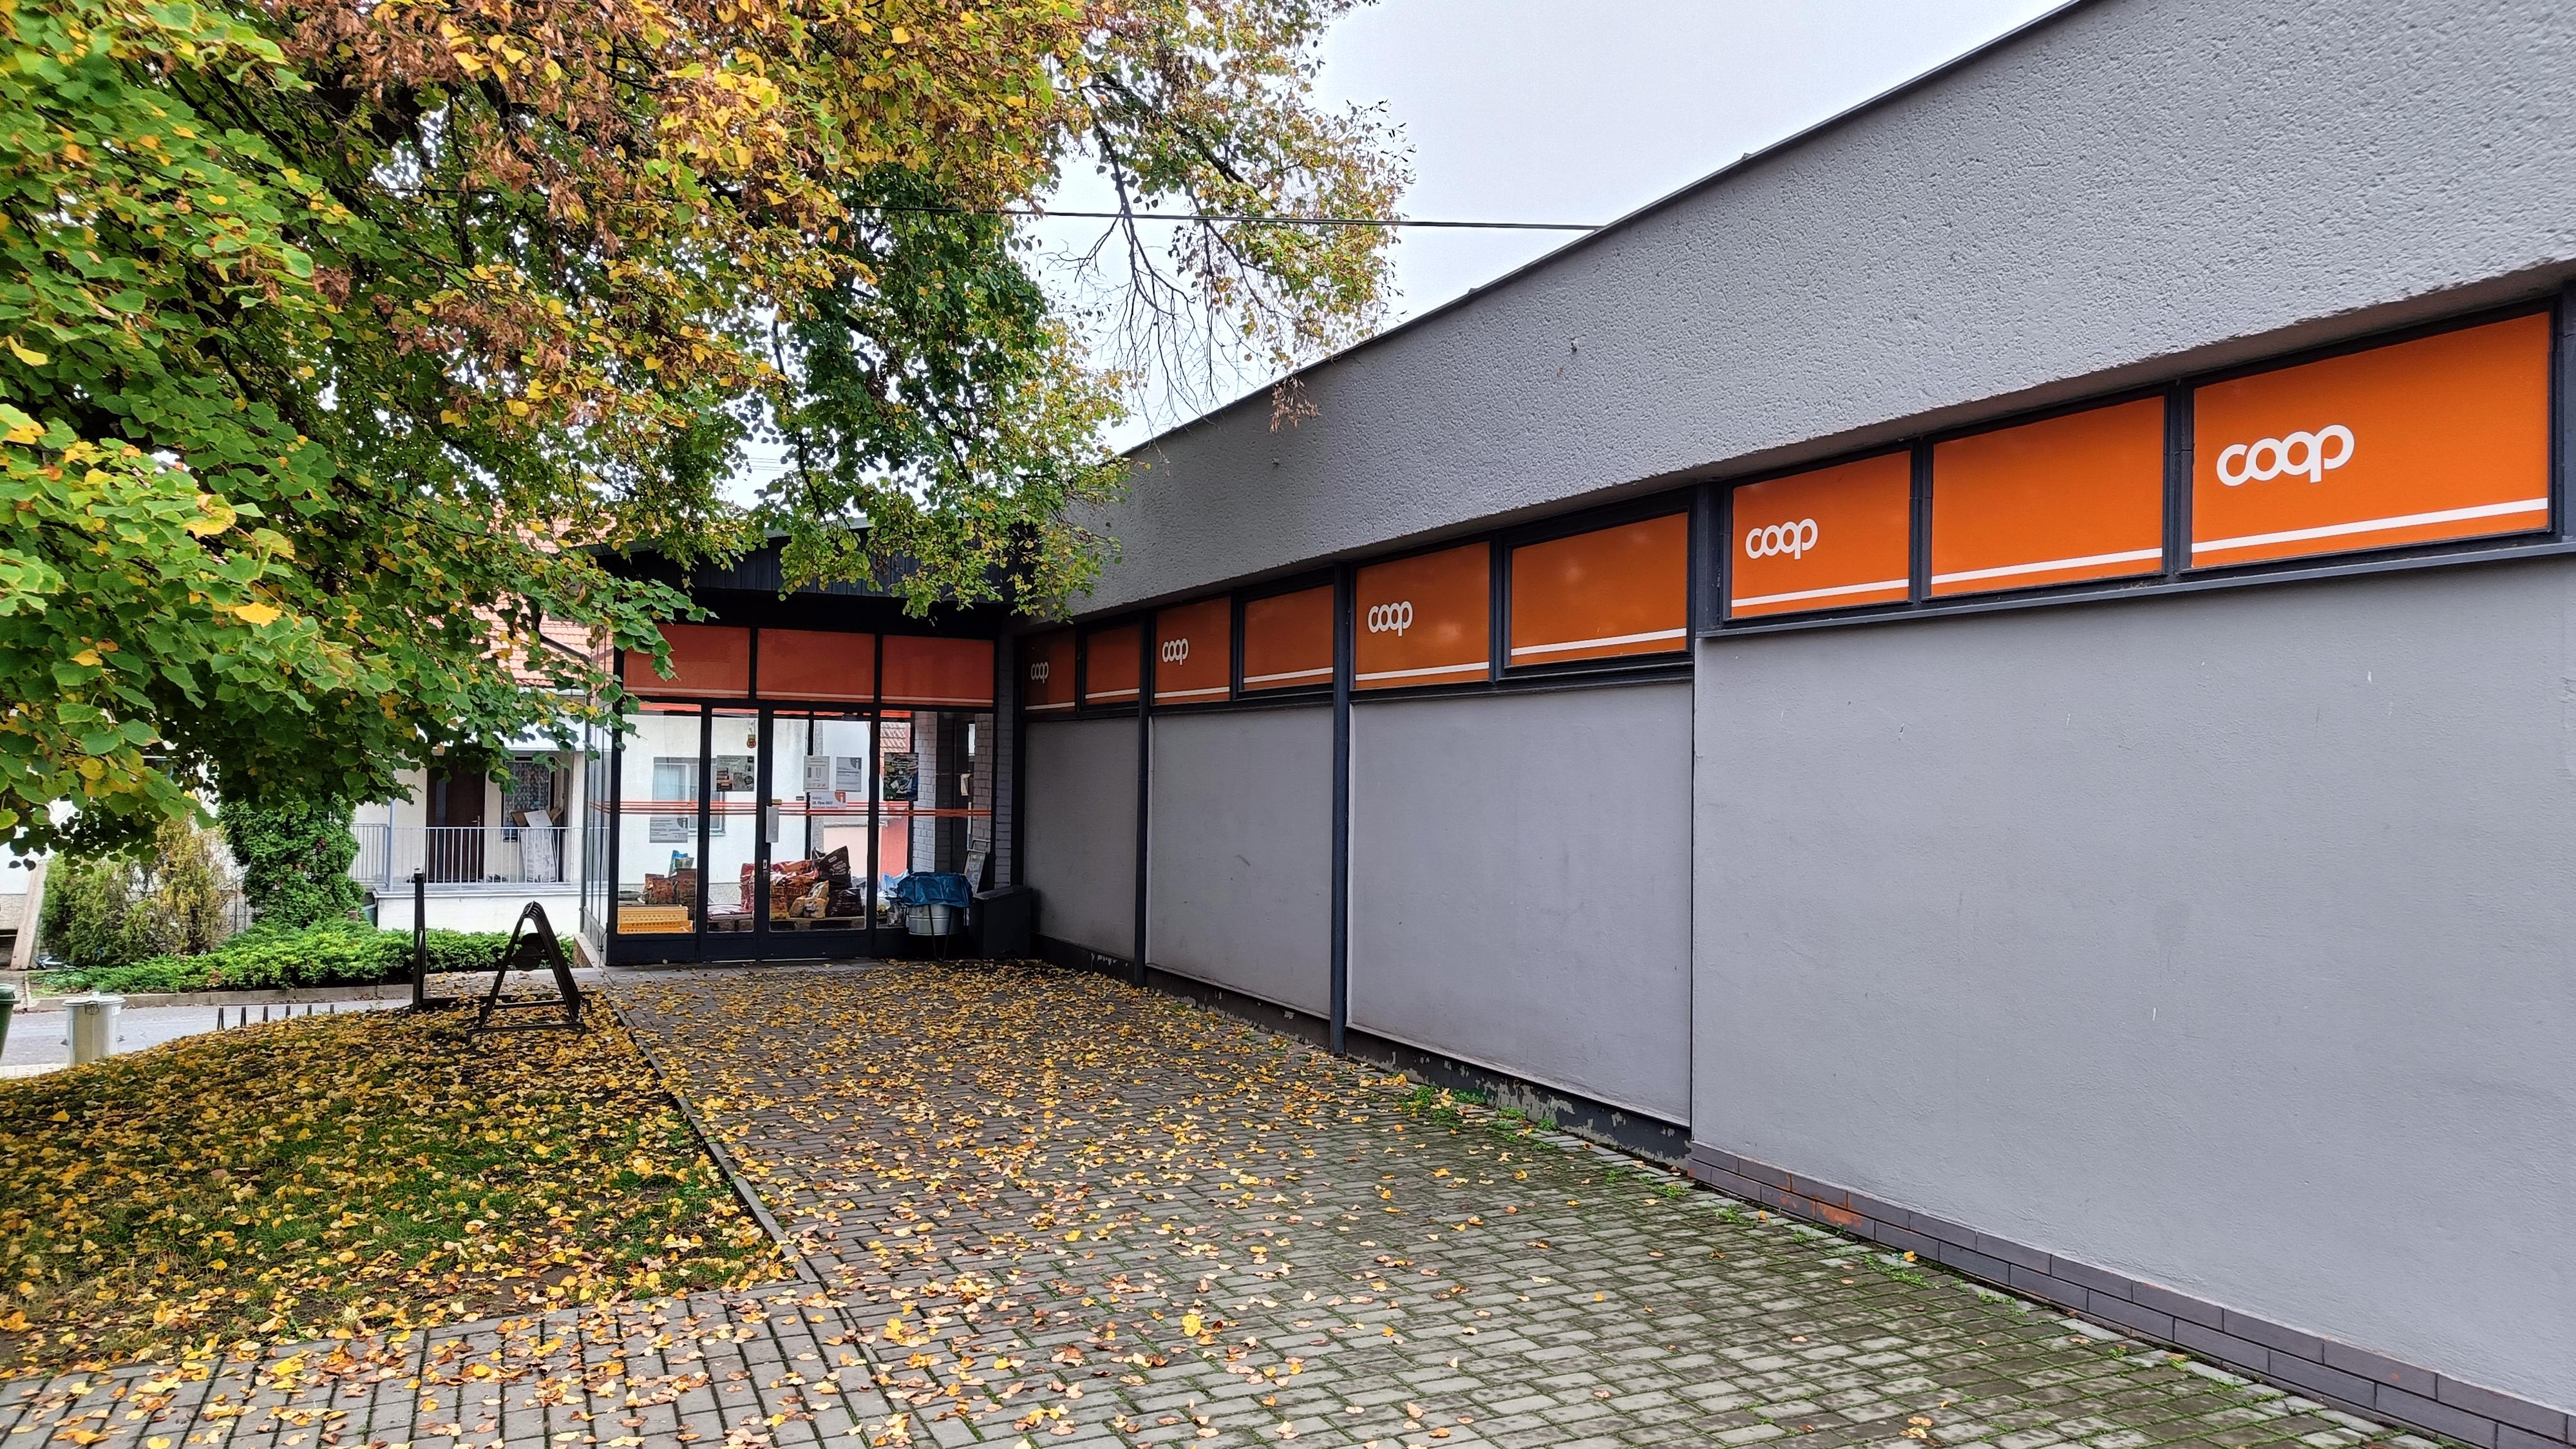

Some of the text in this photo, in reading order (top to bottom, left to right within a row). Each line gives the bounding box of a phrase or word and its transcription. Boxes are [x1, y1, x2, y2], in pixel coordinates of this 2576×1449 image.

[2216, 424, 2355, 487] coop
[1745, 518, 1818, 560] coop
[1368, 601, 1413, 637] coop
[1162, 638, 1189, 666] coop
[1030, 661, 1049, 684] coop
